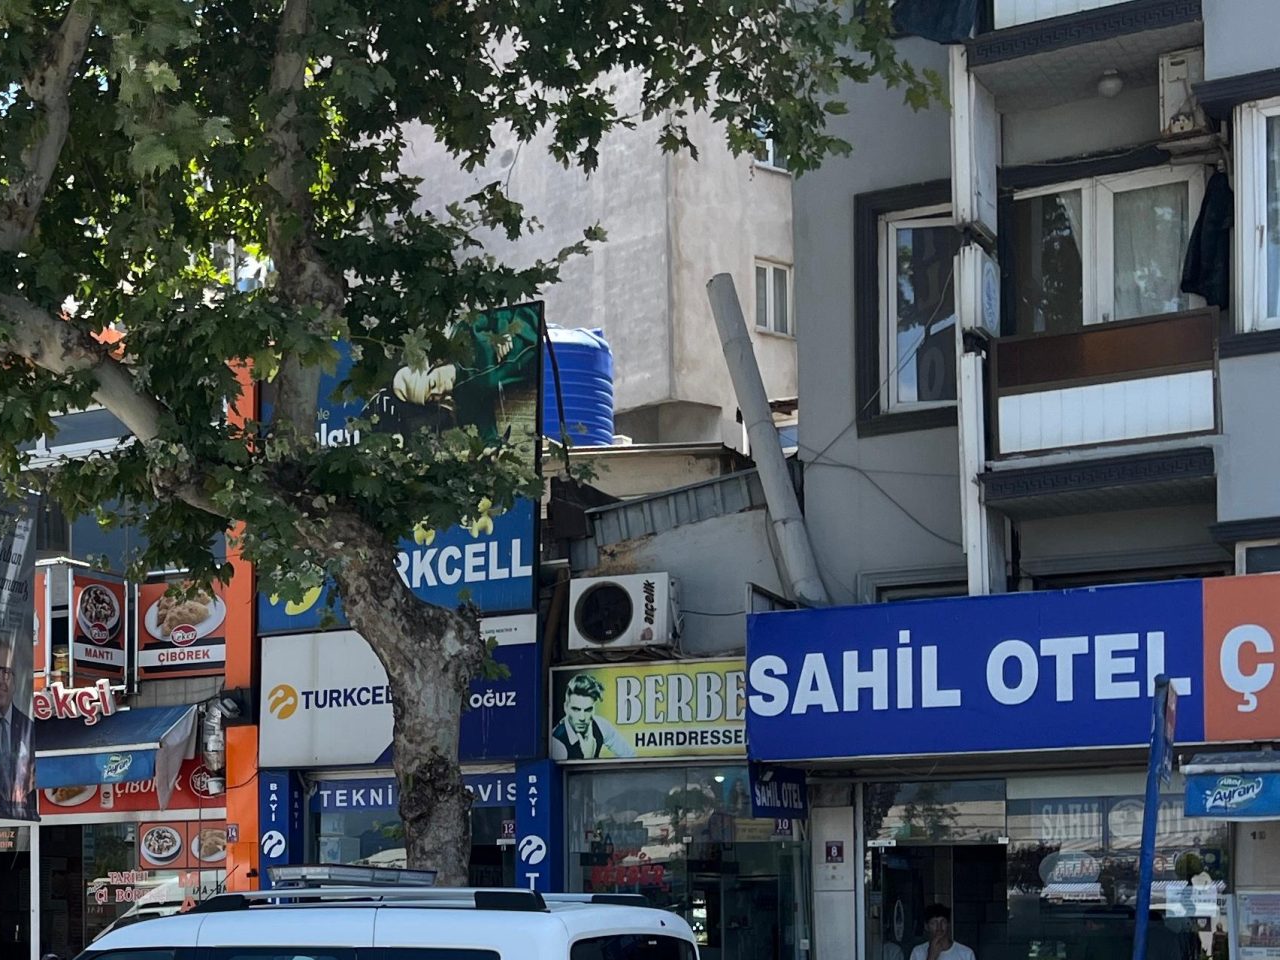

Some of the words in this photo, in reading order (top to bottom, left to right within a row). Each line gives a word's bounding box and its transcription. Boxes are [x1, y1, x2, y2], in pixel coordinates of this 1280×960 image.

[393, 538, 533, 589] RKCELL
[85, 647, 114, 661] MANTI
[748, 629, 962, 718] SAHİL
[986, 630, 1192, 706] OTEL
[1220, 622, 1275, 714] Ç
[301, 685, 393, 710] TURKCEL
[470, 690, 517, 708] OĞUZ
[616, 671, 747, 726] BERBE
[320, 784, 393, 808] TEKNİ
[781, 782, 804, 810] OTEL
[1212, 783, 1256, 804] Ayran
[227, 827, 237, 838] 14
[503, 822, 515, 835] 12
[777, 819, 789, 830] 10
